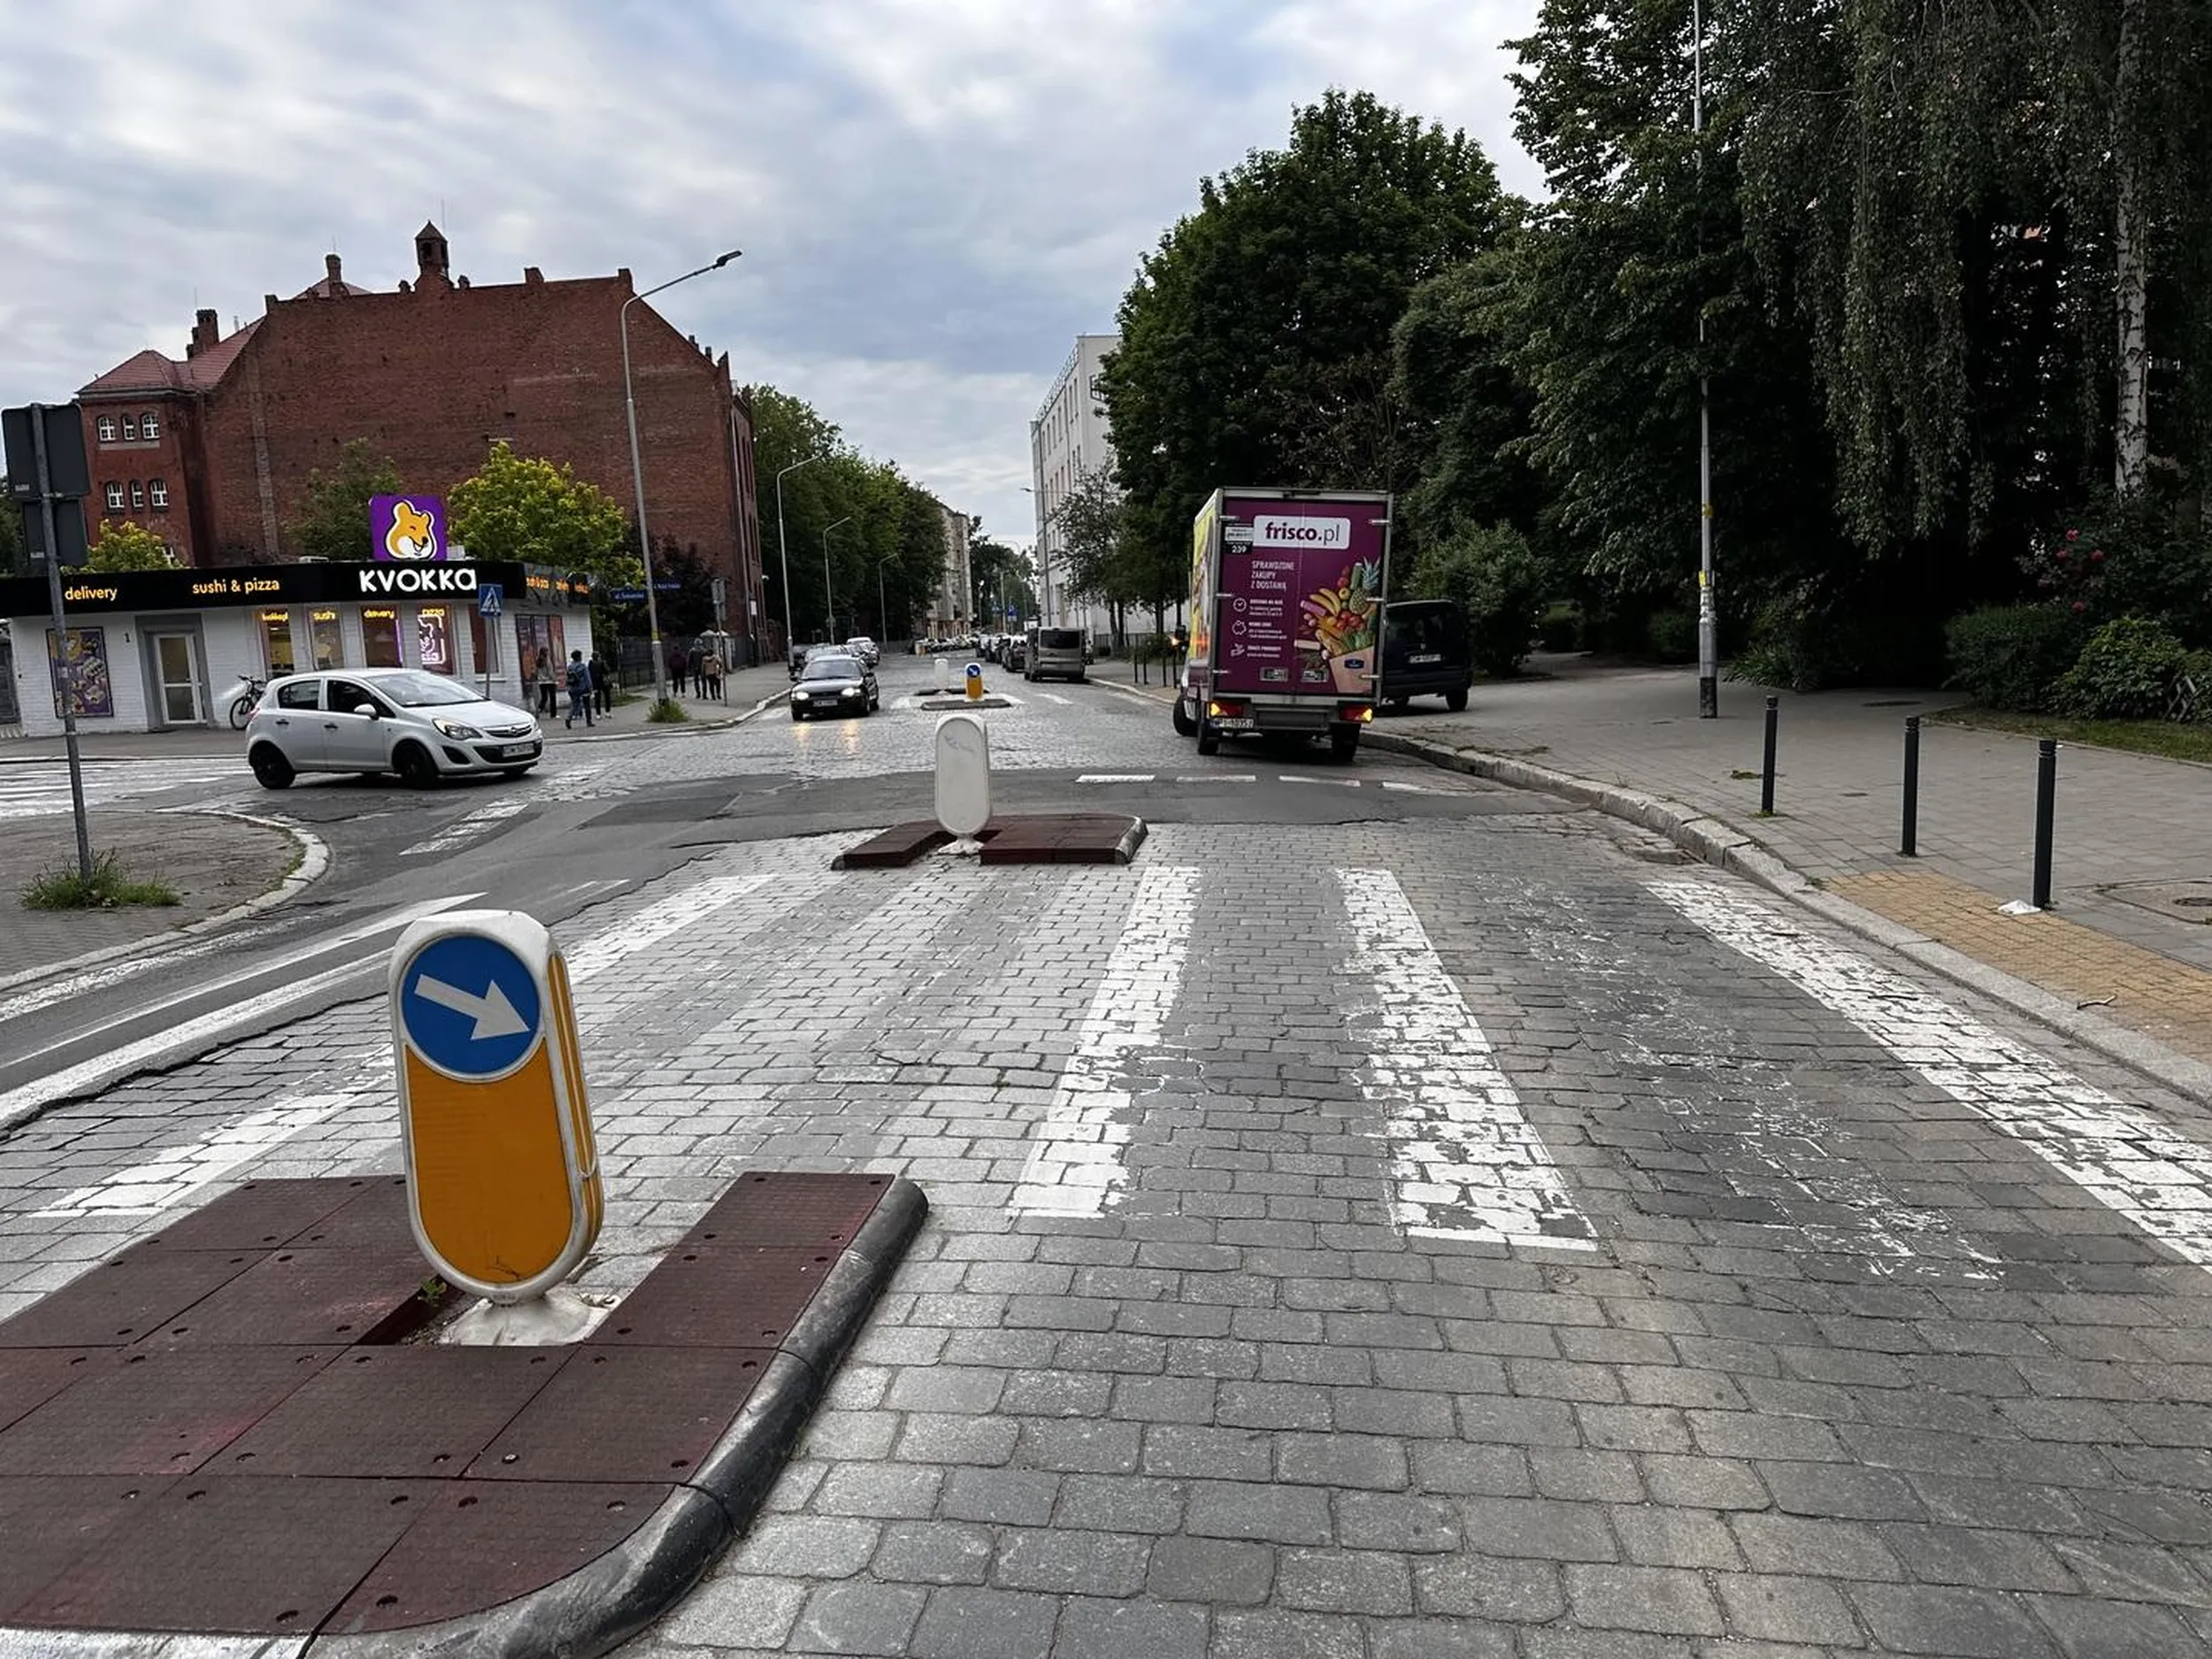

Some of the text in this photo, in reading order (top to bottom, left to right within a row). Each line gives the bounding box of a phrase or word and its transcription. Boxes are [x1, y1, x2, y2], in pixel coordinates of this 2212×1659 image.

[1265, 522, 1340, 546] frisco.pl
[1251, 560, 1294, 571] SPRAWDZONE
[1251, 571, 1277, 580] ZAKUPY
[65, 586, 118, 602] delivery
[192, 577, 280, 595] sushi & pizza
